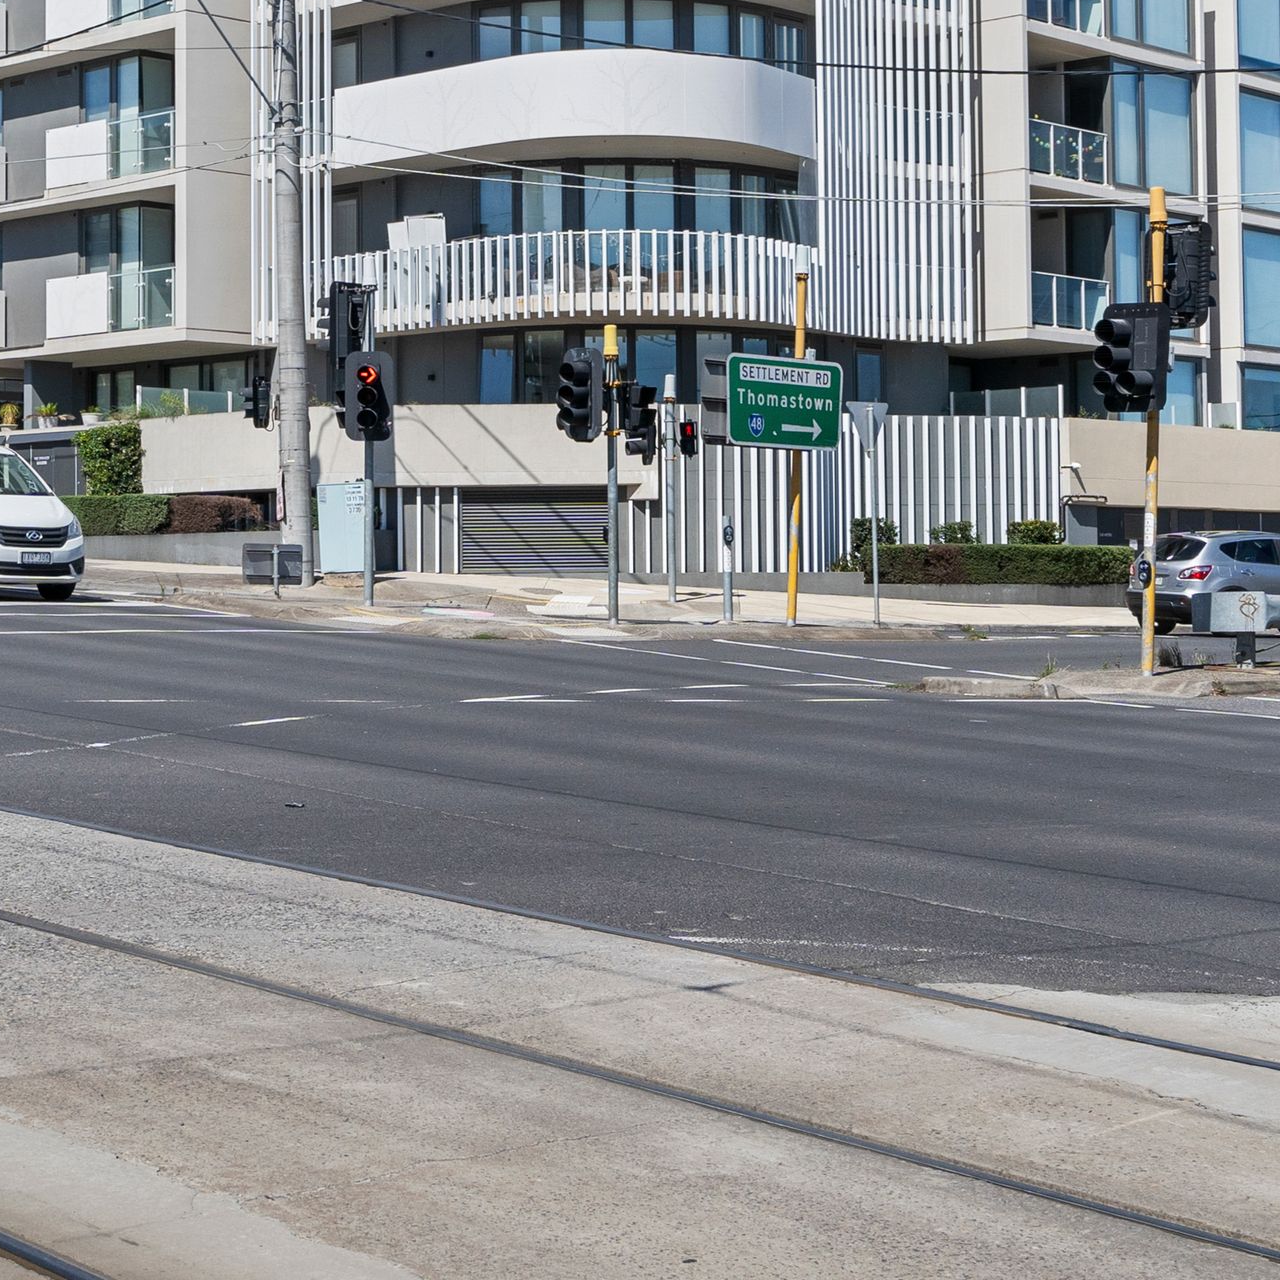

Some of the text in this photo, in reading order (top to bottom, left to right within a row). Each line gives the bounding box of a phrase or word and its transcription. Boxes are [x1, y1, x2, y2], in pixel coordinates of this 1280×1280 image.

[741, 365, 829, 386] SETTLEMENT RD
[737, 387, 833, 412] Thomastown
[750, 417, 762, 430] 48
